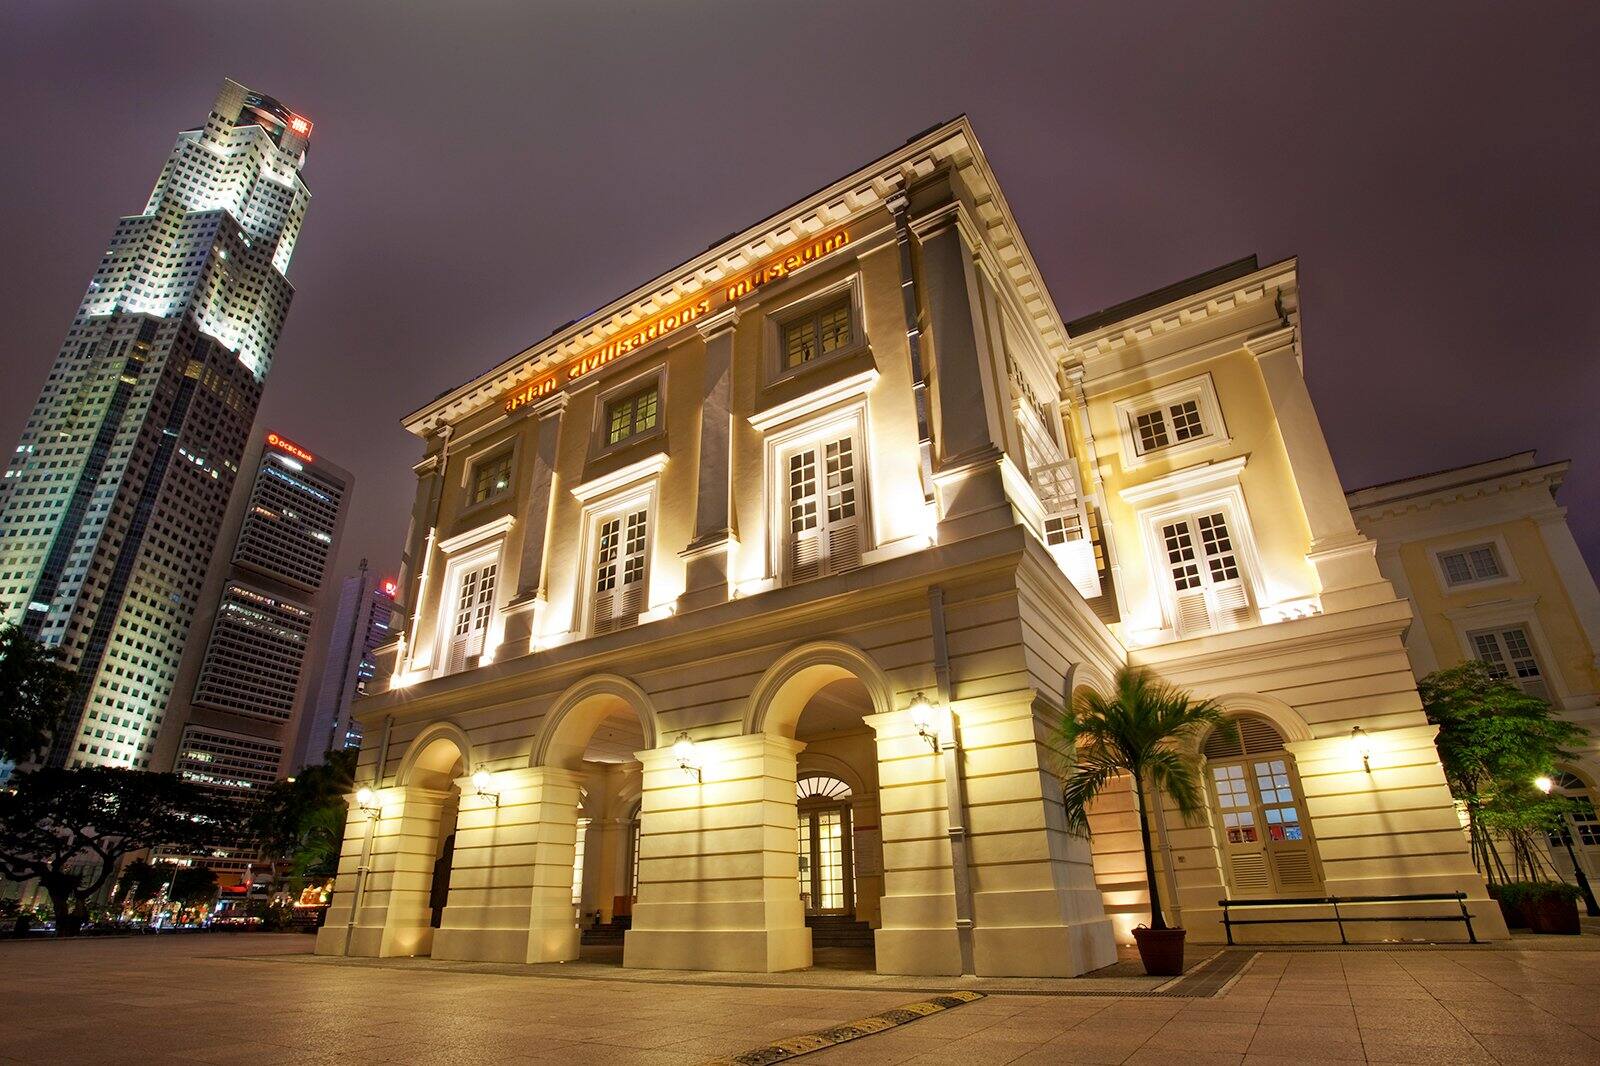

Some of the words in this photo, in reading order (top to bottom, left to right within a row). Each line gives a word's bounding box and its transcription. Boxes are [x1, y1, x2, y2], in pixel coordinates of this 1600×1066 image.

[504, 378, 557, 413] asian
[568, 300, 711, 380] civilisations
[722, 229, 850, 302] museum
[279, 441, 297, 454] OCBC
[297, 450, 312, 461] Bank
